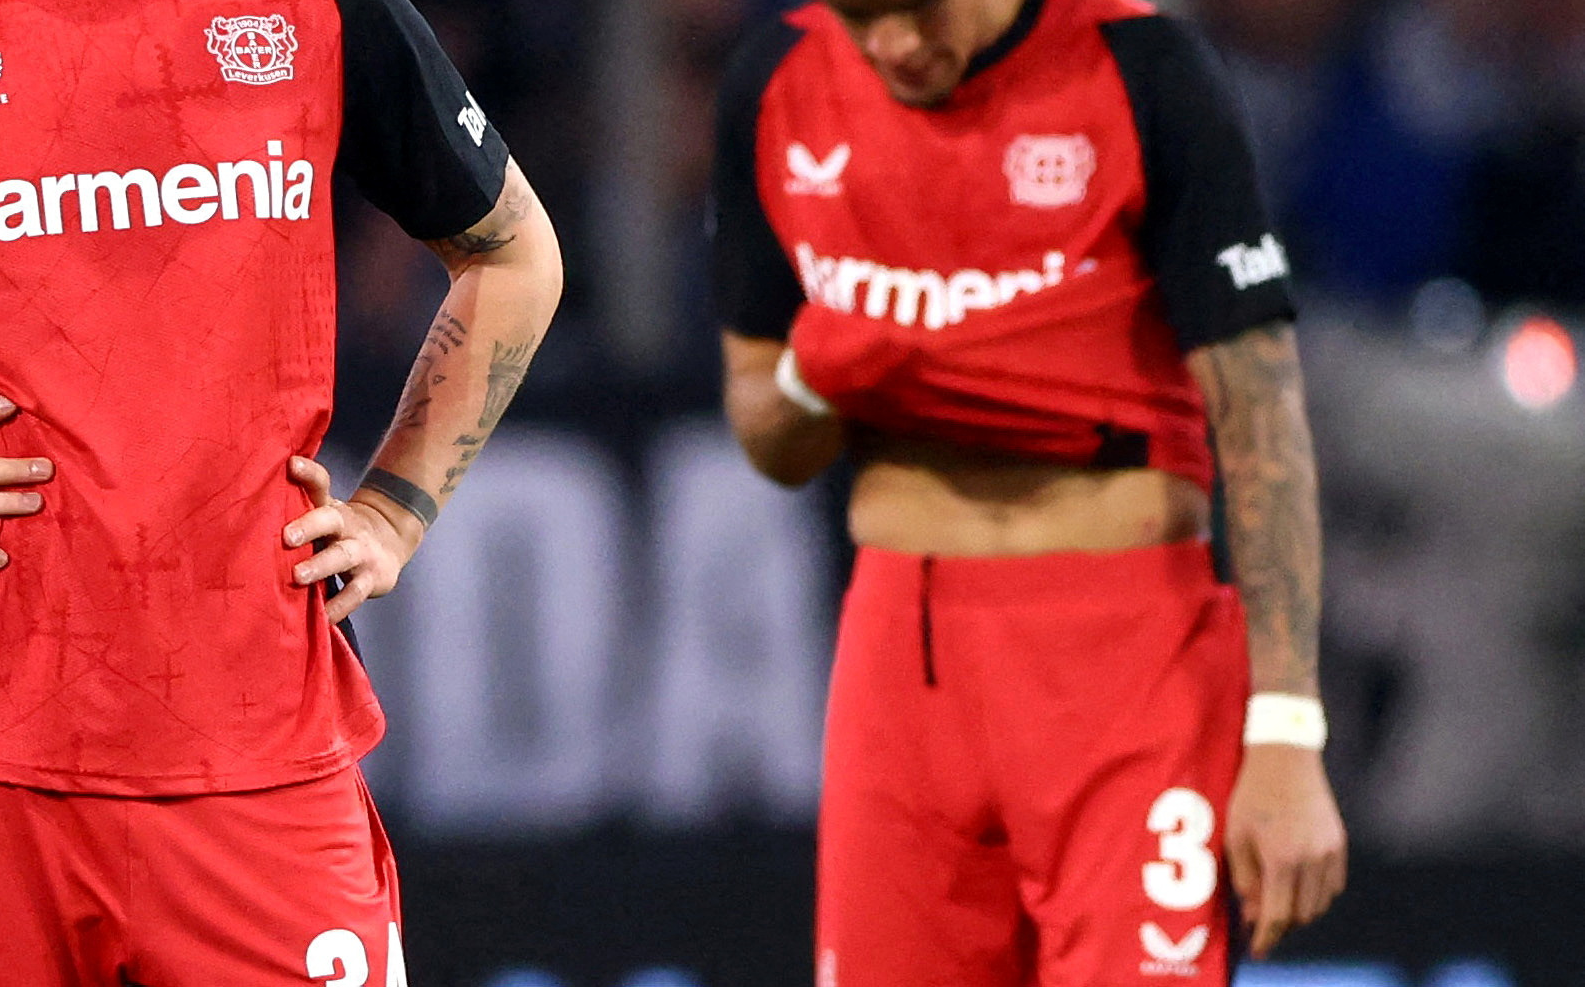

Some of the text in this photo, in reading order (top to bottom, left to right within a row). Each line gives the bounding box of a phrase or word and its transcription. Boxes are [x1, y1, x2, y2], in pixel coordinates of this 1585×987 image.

[235, 46, 273, 55] BAYER
[227, 69, 288, 81] Leverkusen
[1141, 786, 1218, 910] 3
